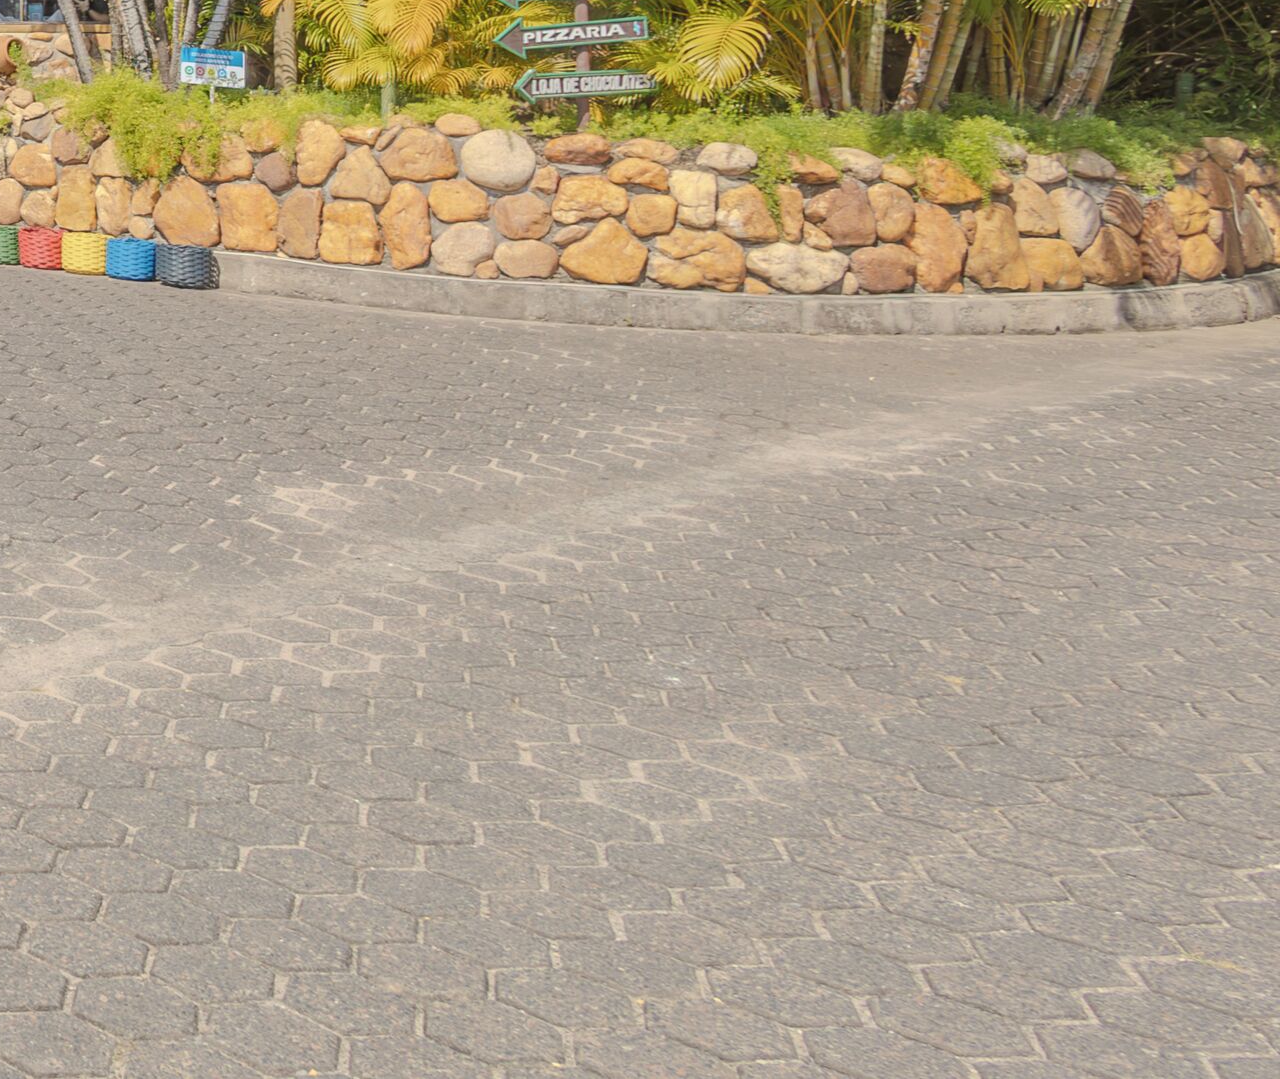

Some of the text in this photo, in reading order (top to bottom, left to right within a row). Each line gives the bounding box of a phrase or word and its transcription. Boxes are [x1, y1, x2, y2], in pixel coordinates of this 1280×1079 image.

[523, 24, 625, 44] PIZZARIA
[531, 75, 650, 95] LOJA DE CHOCOLATES
